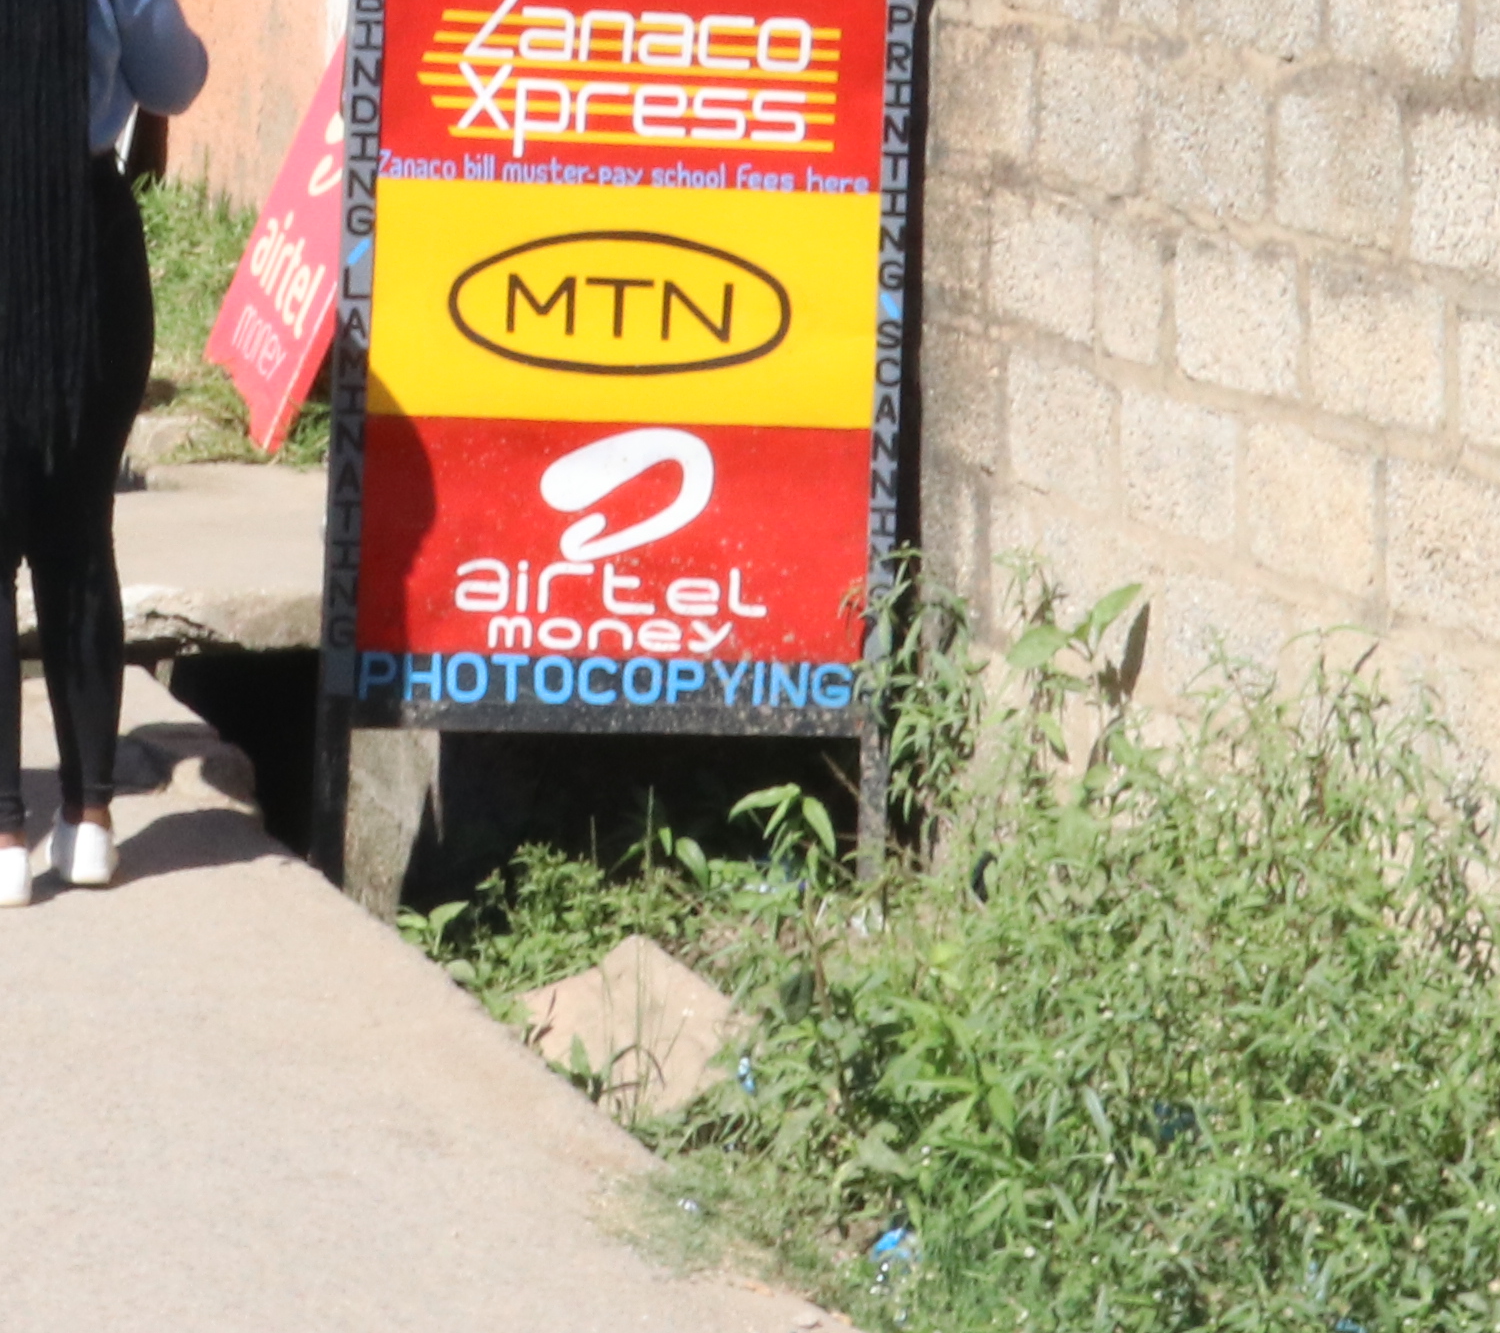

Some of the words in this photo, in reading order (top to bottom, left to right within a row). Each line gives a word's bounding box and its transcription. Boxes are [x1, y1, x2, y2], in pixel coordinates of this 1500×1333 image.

[456, 60, 808, 158] Xpress
[377, 147, 457, 180] Zanaco
[463, 152, 496, 182] bill
[651, 159, 727, 189] school
[806, 165, 870, 195] here
[249, 210, 327, 340] airtel
[505, 272, 735, 344] MTN
[230, 302, 289, 382] money
[454, 557, 768, 618] airtel
[486, 615, 734, 653] money
[358, 650, 856, 709] PHOTOCOPYING
